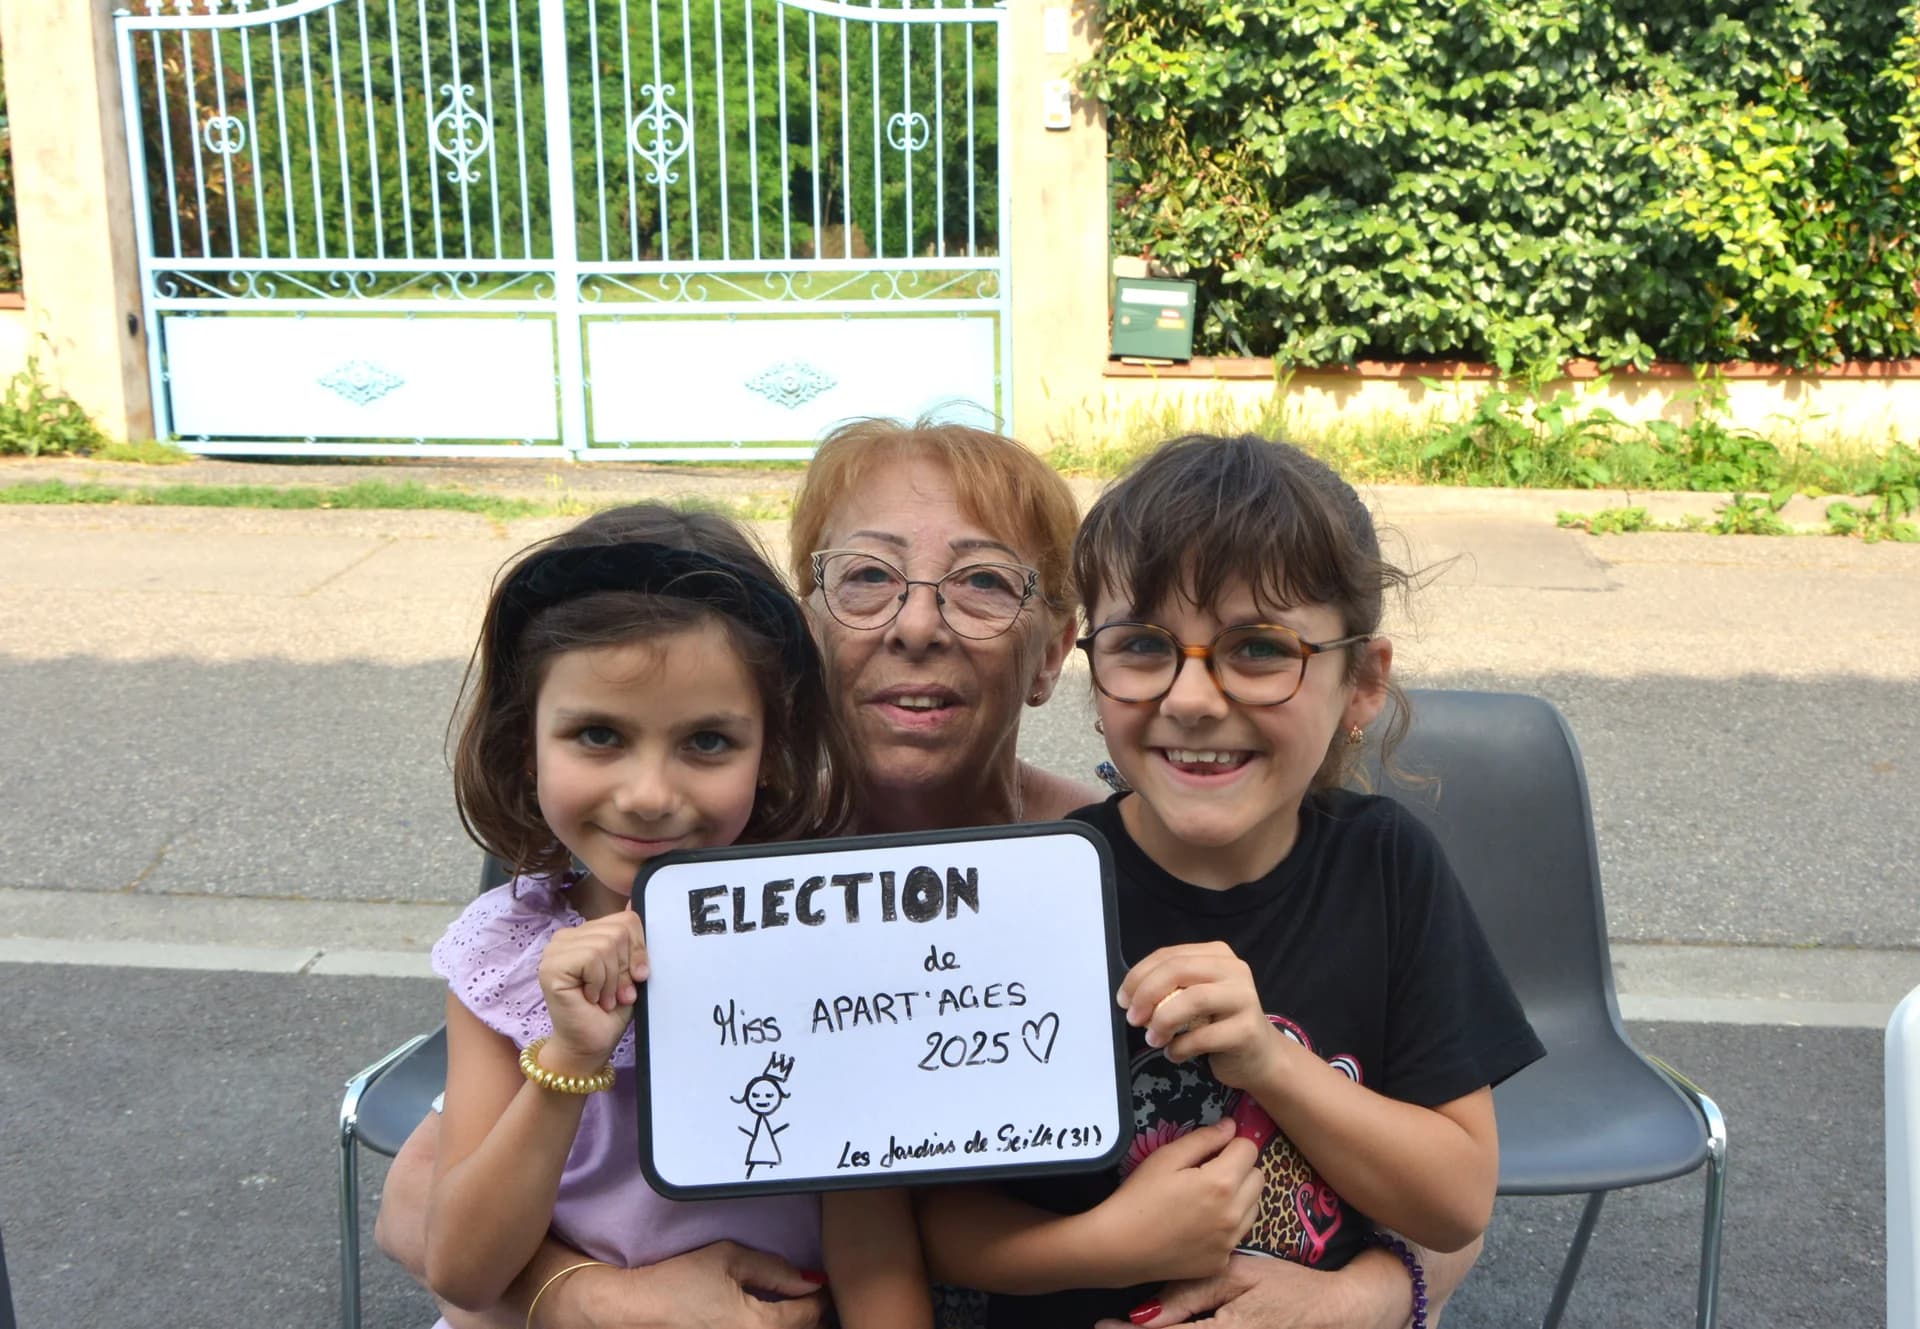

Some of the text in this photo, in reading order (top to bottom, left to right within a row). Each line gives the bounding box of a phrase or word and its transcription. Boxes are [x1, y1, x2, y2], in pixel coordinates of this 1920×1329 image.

[688, 865, 980, 936] ELECTION
[923, 944, 961, 972] de
[713, 982, 1027, 1046] Miss APART'AGES
[917, 1031, 1010, 1071] 2025
[837, 1141, 870, 1169] Les
[879, 1132, 957, 1168] Jardins
[963, 1129, 988, 1154] de
[1056, 1124, 1102, 1150] (31)
